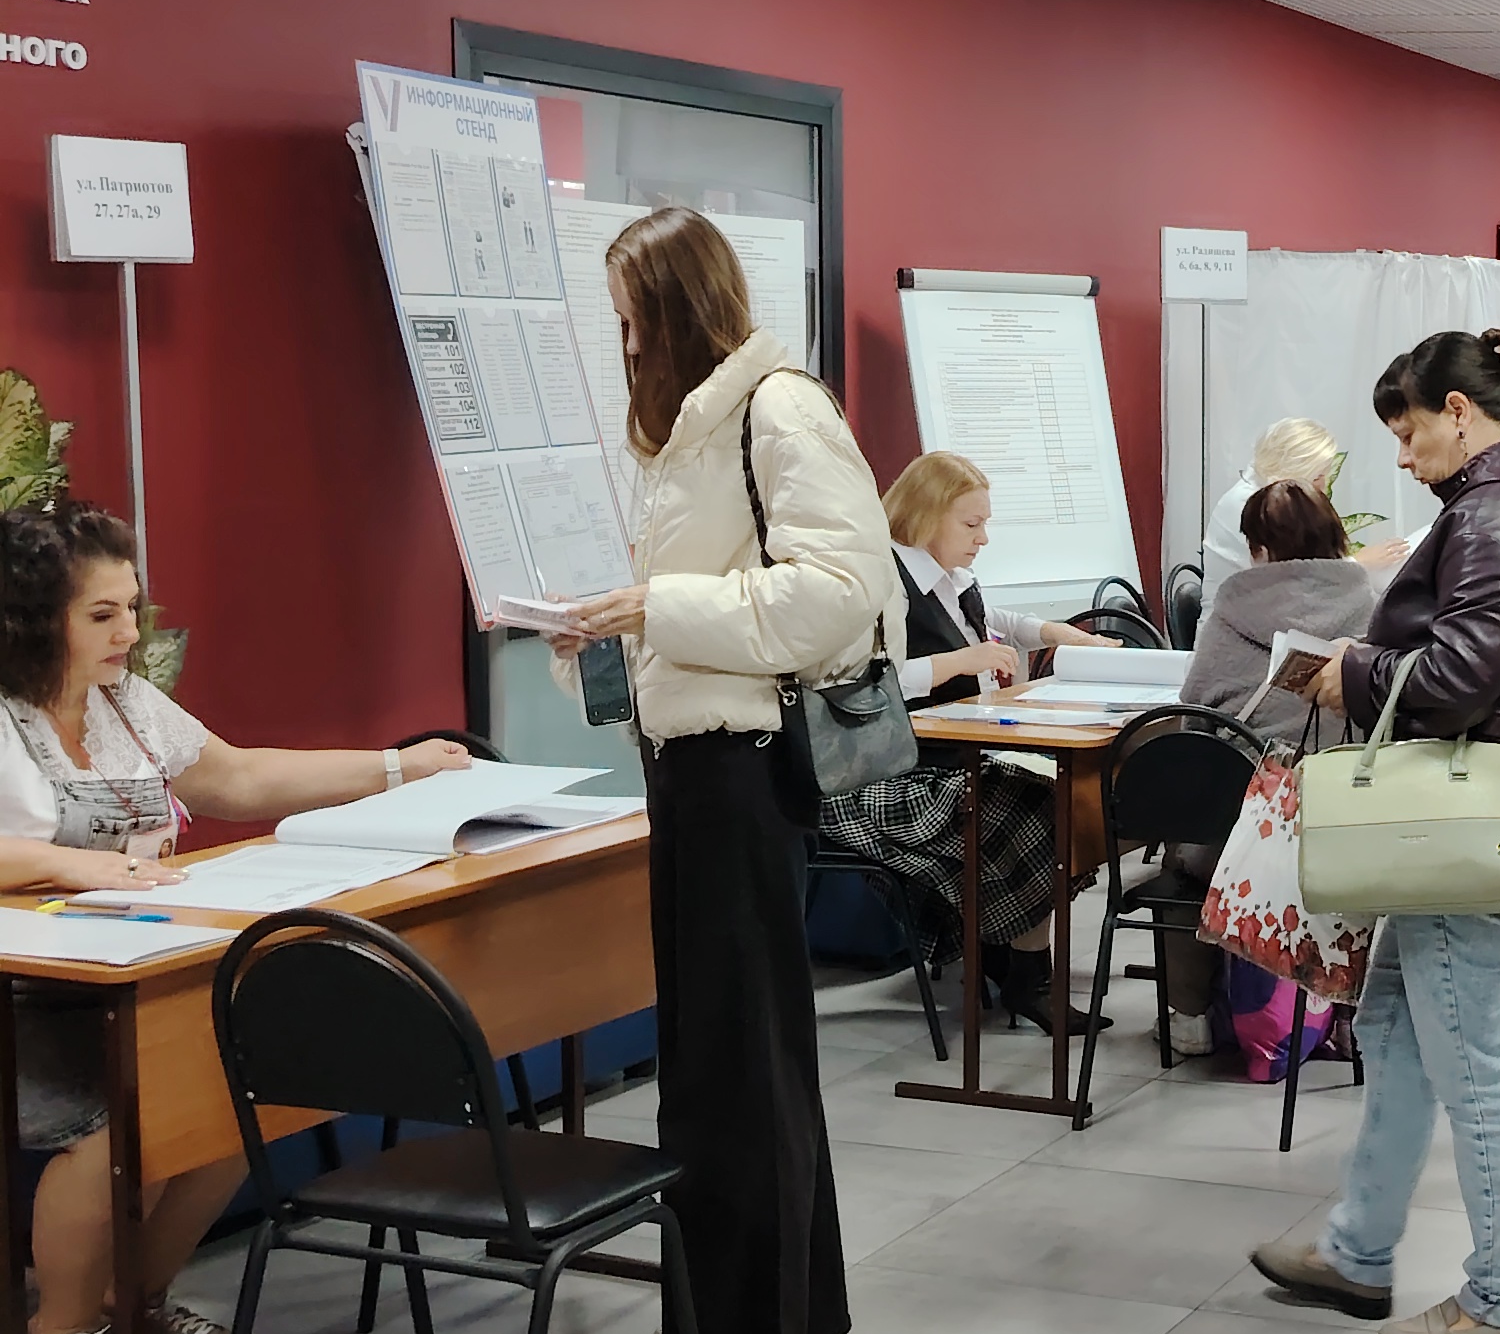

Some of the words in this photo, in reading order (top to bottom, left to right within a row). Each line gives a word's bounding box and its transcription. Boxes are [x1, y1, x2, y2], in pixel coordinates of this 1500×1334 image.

[406, 85, 535, 124] ИНФОРМАЦИОННЫЙ
[456, 118, 498, 144] СТЕНД
[76, 179, 97, 194] ул.
[99, 176, 173, 197] Патриотов
[94, 202, 114, 220] 27,
[116, 203, 144, 220] 27а,
[146, 204, 161, 220] 29
[444, 344, 461, 357] 101
[449, 363, 466, 375] 102
[454, 381, 471, 394] 103
[459, 400, 476, 412] 104
[463, 417, 481, 430] 112
